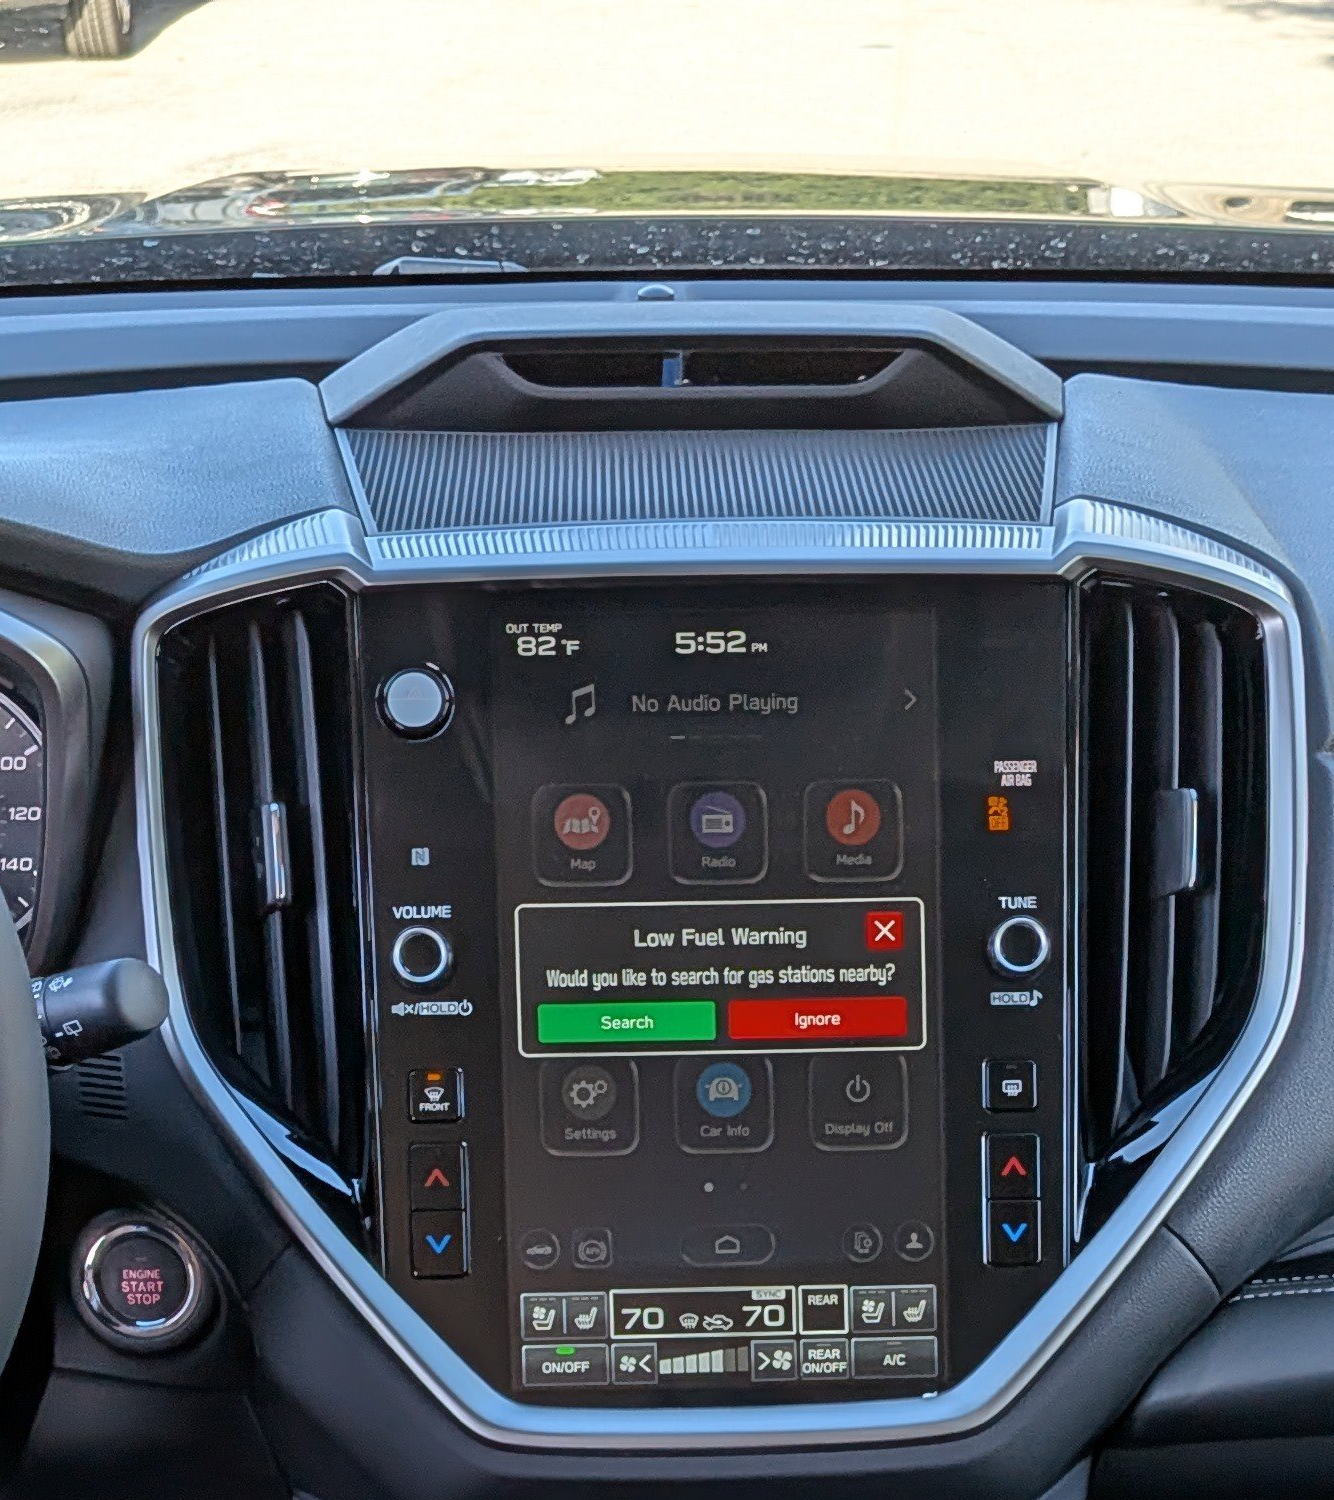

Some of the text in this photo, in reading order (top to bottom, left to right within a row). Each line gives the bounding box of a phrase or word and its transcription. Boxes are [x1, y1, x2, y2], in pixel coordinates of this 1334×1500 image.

[506, 623, 563, 634] OUT TEMP
[517, 636, 557, 656] 82
[674, 630, 768, 654] 5:52 PM
[632, 692, 799, 714] No Audio Playing
[993, 760, 1038, 774] PASSENGER
[1000, 773, 1033, 787] AIR BAG
[8, 806, 42, 821] 120
[0, 857, 33, 872] 140
[570, 858, 596, 872] Map
[701, 856, 736, 870] Radio
[836, 853, 873, 867] Media
[998, 895, 1039, 910] TUNE
[392, 904, 452, 919] VOLUME
[633, 926, 808, 949] Low Fuel Warning
[546, 962, 896, 991] Would you like to search for gas stations nearby?
[991, 992, 1031, 1006] HOLD
[600, 1014, 654, 1030] Search
[794, 1012, 841, 1029] Ignore
[419, 1102, 451, 1112] FRONT
[564, 1126, 617, 1143] Settings
[699, 1123, 750, 1138] Car Info
[825, 1120, 893, 1138] Display Off
[122, 1268, 161, 1280] ENGINE
[120, 1280, 164, 1293] START
[752, 1288, 785, 1300] SYNC
[126, 1293, 161, 1306] STOP
[807, 1293, 839, 1306] REAR
[620, 1306, 665, 1331] 70
[742, 1303, 786, 1328] 70
[807, 1347, 841, 1361] REAR
[882, 1353, 906, 1367] A/C
[541, 1360, 590, 1376] ON/OFF
[802, 1361, 848, 1376] ON/OFF
